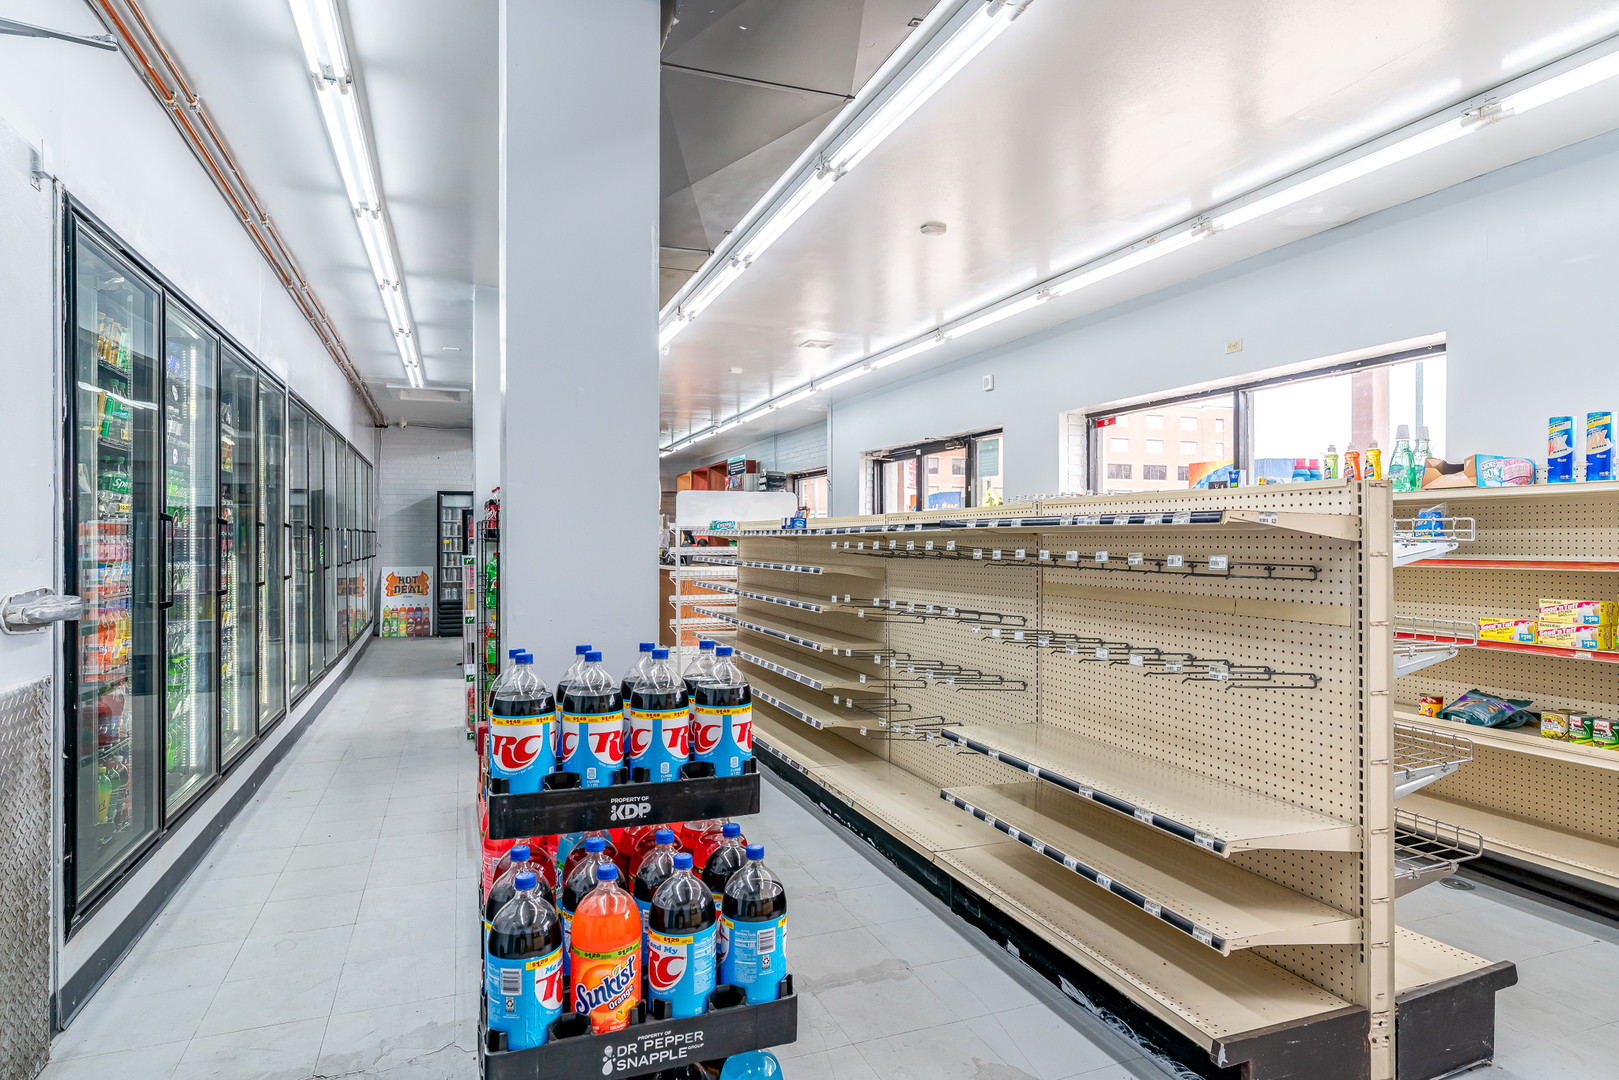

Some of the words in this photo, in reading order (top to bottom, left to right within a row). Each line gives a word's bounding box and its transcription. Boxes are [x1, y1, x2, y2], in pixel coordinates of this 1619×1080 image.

[394, 585, 424, 594] DEAL
[398, 576, 418, 584] HOT
[562, 732, 578, 760] C
[630, 726, 652, 756] C
[663, 725, 689, 756] R
[732, 721, 752, 749] R
[492, 734, 542, 769] RC
[616, 803, 651, 820] KDP
[664, 946, 678, 955] My
[545, 964, 556, 974] Me
[648, 946, 686, 988] RC
[536, 966, 563, 1003] R
[576, 954, 636, 1015] Sunkist
[608, 984, 634, 1010] Orange
[617, 1043, 638, 1057] DR
[644, 1031, 704, 1051] PEPPER
[638, 1032, 663, 1040] PROPERTY
[616, 1047, 688, 1071] SNAPPLE
